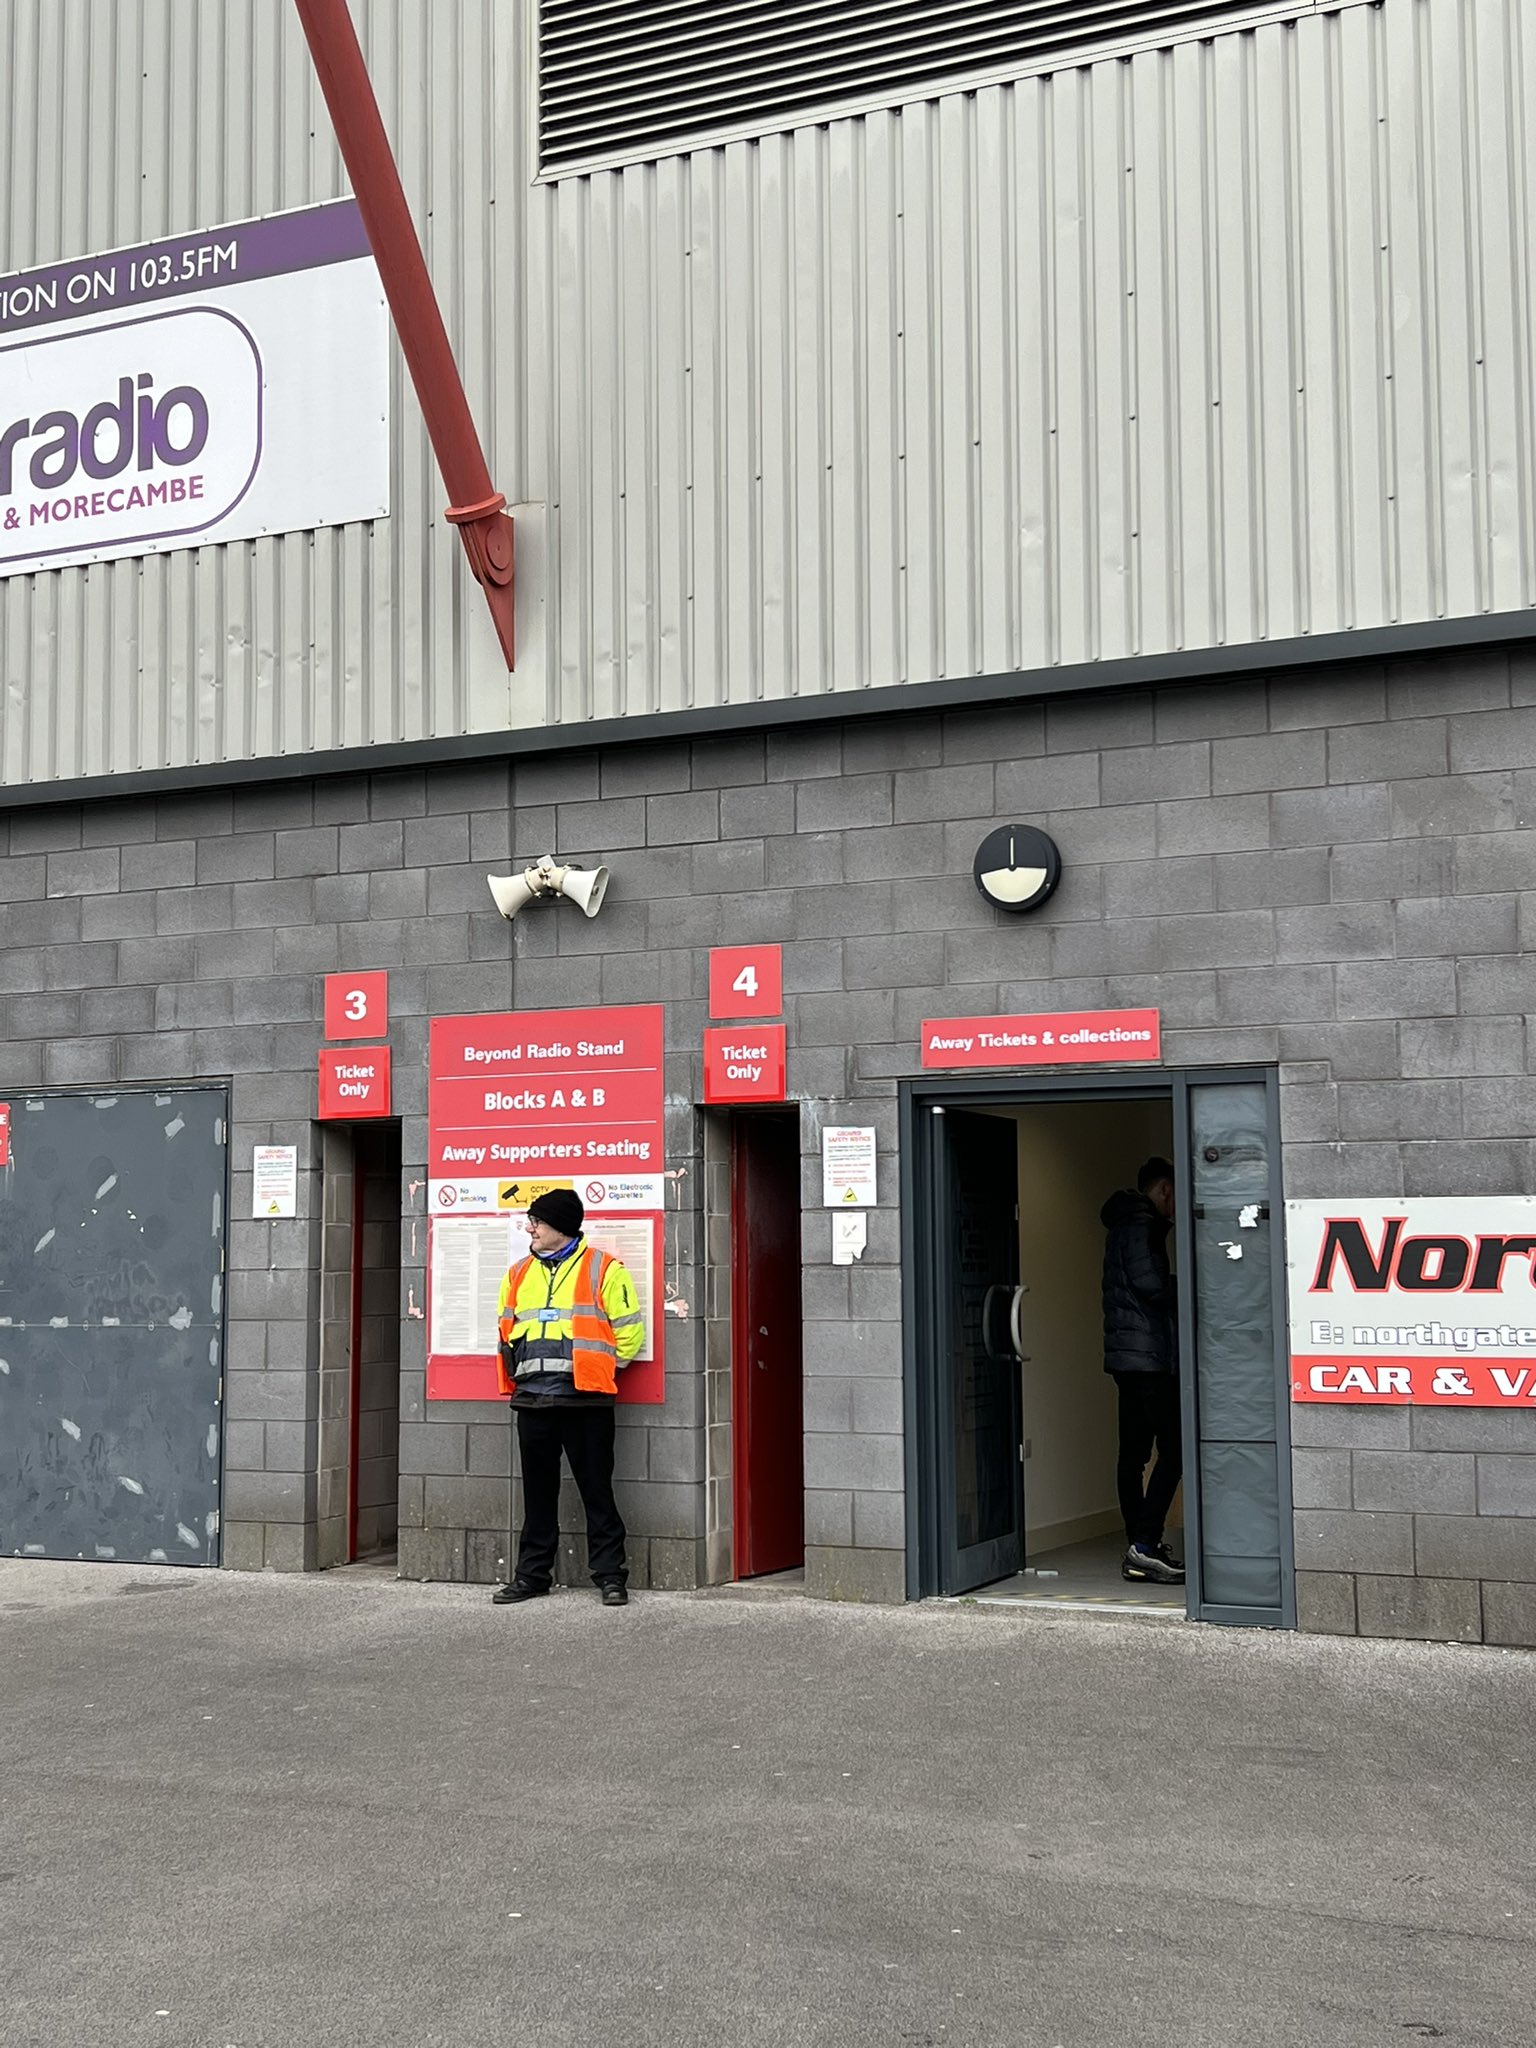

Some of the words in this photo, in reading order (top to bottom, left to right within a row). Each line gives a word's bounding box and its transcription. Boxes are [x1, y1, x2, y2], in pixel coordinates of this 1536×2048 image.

[0, 280, 57, 319] ION
[66, 266, 116, 304] ON
[129, 241, 238, 292] 103.5FM
[0, 372, 210, 496] radio
[3, 507, 21, 530] &
[29, 475, 204, 526] MORECAMBE
[732, 966, 759, 997] 4
[344, 990, 367, 1021] 3
[464, 1045, 522, 1064] Beyond
[527, 1043, 572, 1059] Radio
[576, 1039, 624, 1056] Stand
[929, 1035, 973, 1052] Away
[977, 1032, 1037, 1048] Tickets
[1041, 1031, 1055, 1045] &
[1058, 1027, 1151, 1044] collections
[721, 1045, 767, 1061] Ticket
[334, 1065, 375, 1079] Ticket
[726, 1063, 762, 1082] Only
[338, 1082, 369, 1099] Only
[484, 1090, 546, 1111] Blocks
[550, 1089, 566, 1108] A
[570, 1088, 587, 1108] &
[592, 1088, 606, 1107] B
[442, 1145, 486, 1164] Away
[490, 1143, 582, 1163] Supporters
[586, 1139, 650, 1159] Seating
[460, 1194, 487, 1203] smoking
[530, 1185, 550, 1193] CCTV
[608, 1191, 643, 1200] Cigarettes
[620, 1183, 653, 1191] Electronic
[1307, 1216, 1536, 1293] Nor
[1310, 1320, 1345, 1345] E:
[1308, 1365, 1414, 1395] CAR
[1431, 1367, 1475, 1396] &
[1487, 1367, 1536, 1397] V
